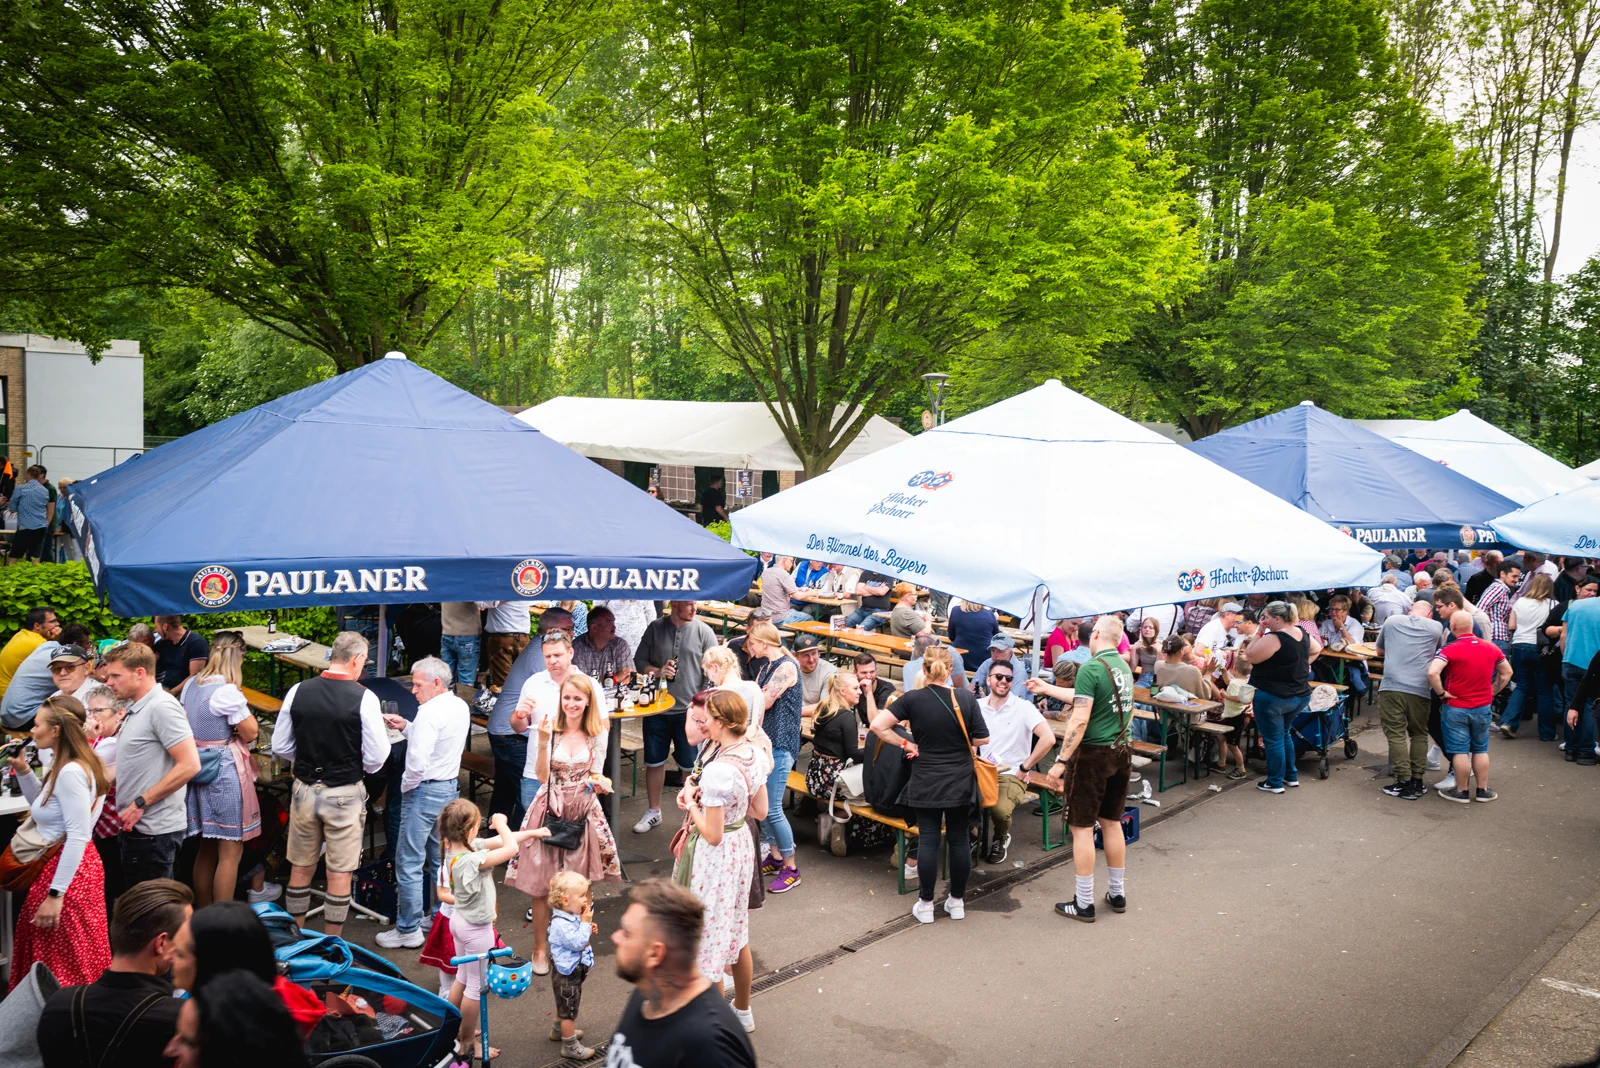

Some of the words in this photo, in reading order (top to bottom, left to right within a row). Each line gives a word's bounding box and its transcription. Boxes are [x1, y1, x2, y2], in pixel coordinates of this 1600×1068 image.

[881, 492, 928, 507] Hacker
[866, 503, 915, 519] Pschorr
[1355, 527, 1427, 543] PAULANER
[1574, 534, 1598, 549] Der
[806, 533, 825, 551] Der
[826, 536, 863, 558] Himmel
[863, 545, 880, 562] der
[880, 548, 928, 576] Bayern
[194, 567, 234, 584] PAULANER
[244, 565, 430, 598] PAULANER
[553, 565, 701, 592] PAULANER
[1209, 565, 1290, 589] Hacker-Pschorr
